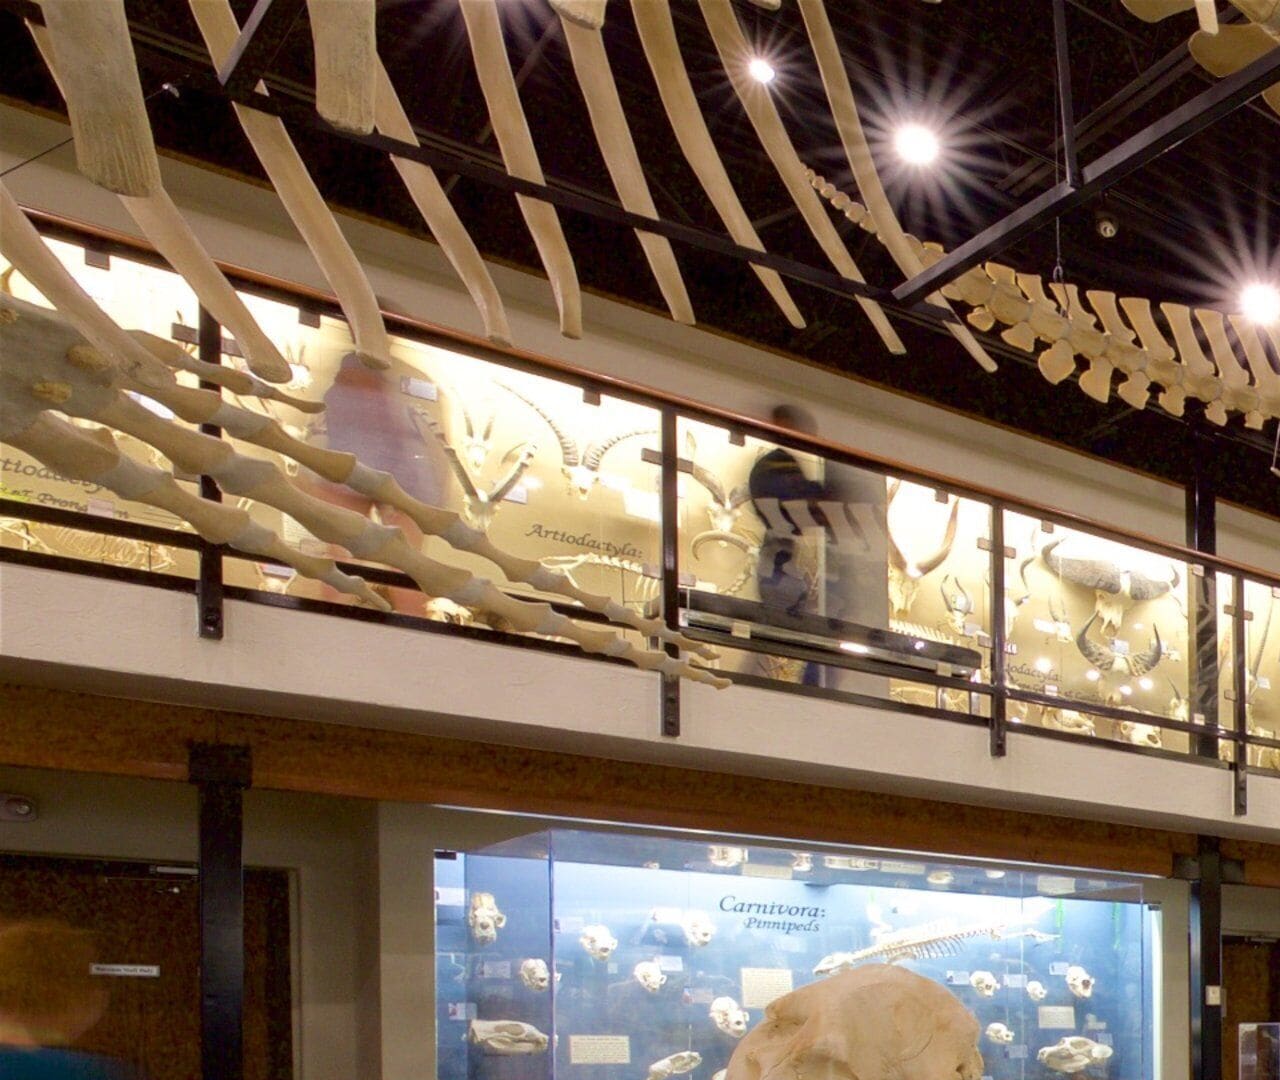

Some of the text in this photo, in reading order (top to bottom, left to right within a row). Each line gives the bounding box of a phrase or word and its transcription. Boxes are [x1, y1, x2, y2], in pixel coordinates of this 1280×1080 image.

[525, 523, 644, 559] Artiodactyla:
[719, 895, 827, 918] Carnivora:
[743, 917, 820, 936] Pinnipeds
